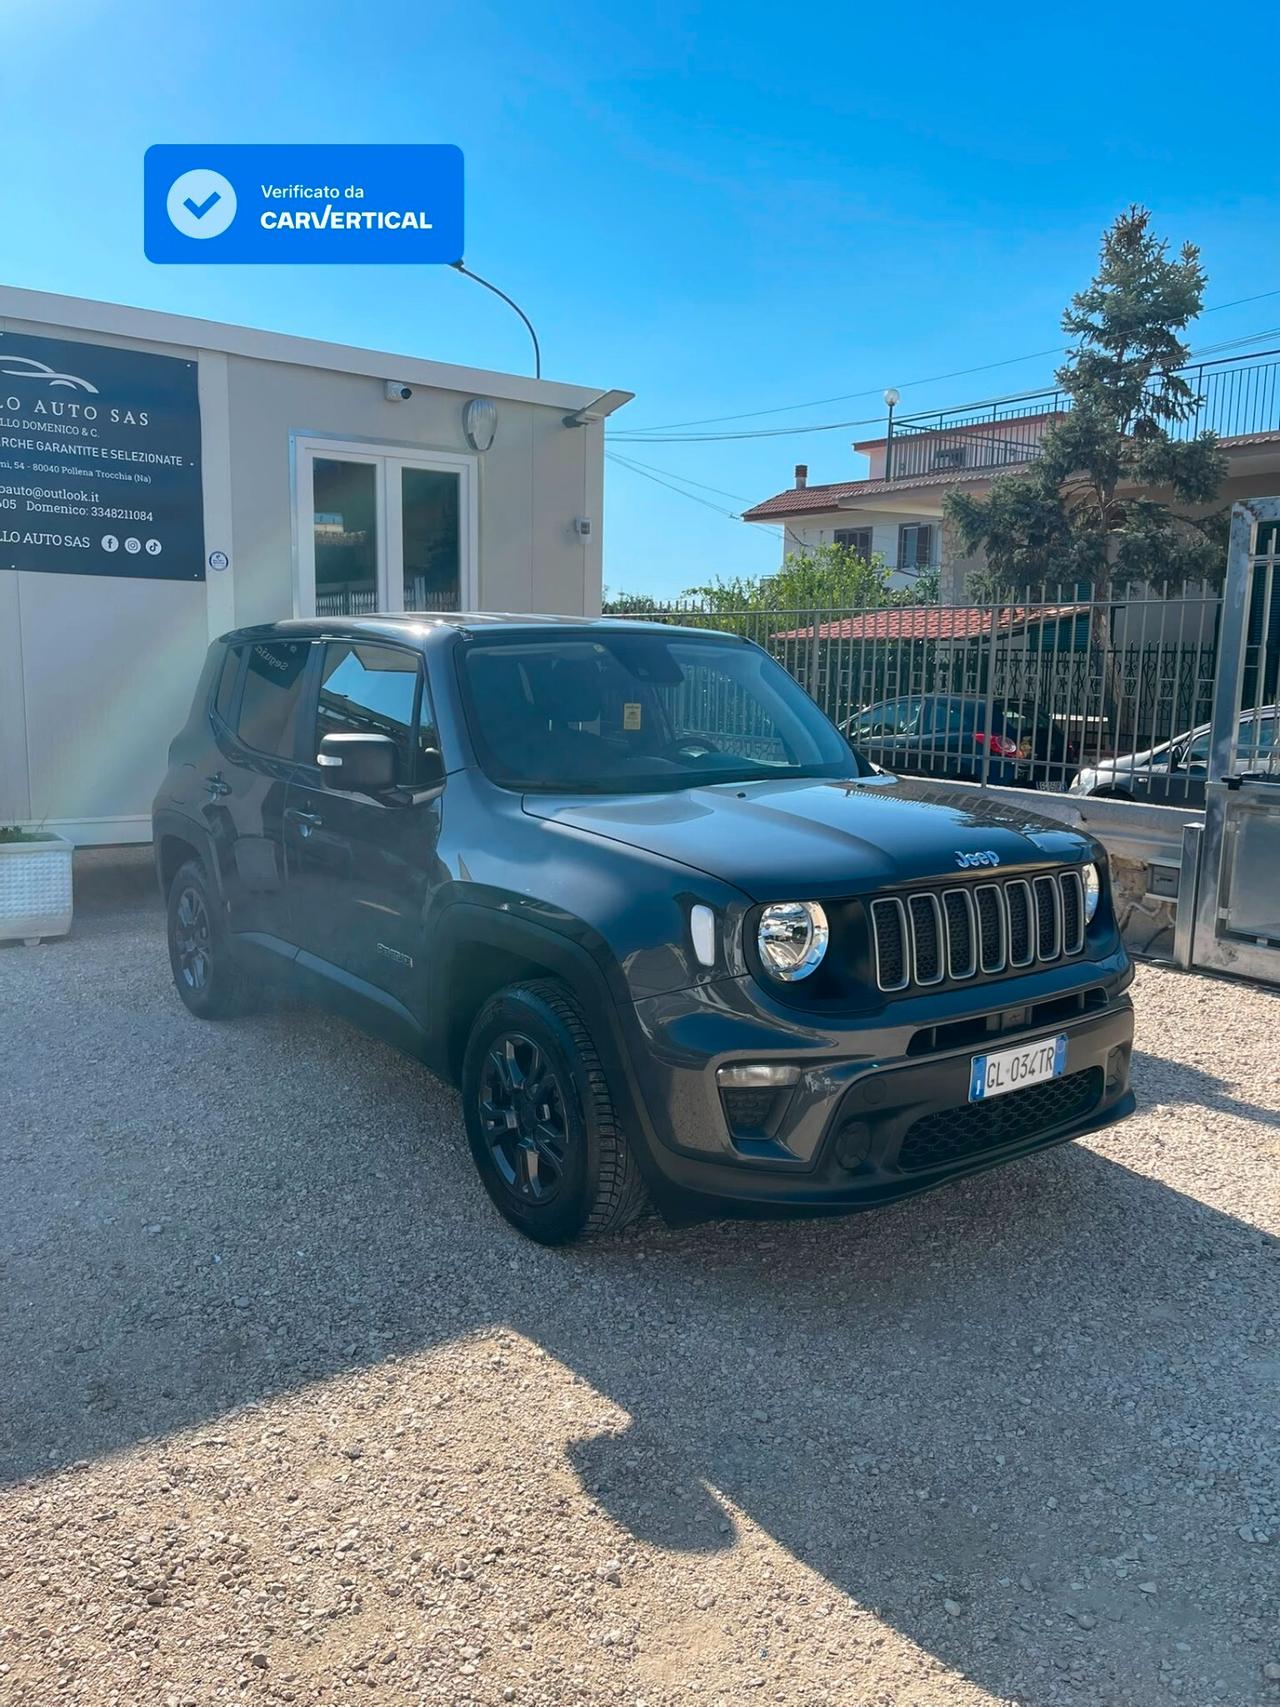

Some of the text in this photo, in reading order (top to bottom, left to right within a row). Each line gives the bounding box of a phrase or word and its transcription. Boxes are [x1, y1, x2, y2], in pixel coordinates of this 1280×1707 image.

[0, 396, 149, 427] O AUTO SAS
[22, 419, 80, 436] DOMENICO
[81, 427, 89, 436] &
[90, 428, 100, 438] C.
[0, 437, 183, 467] RCHE GARANTITE E SELEZIONATE
[14, 461, 25, 470] 54
[32, 463, 60, 474] 80040
[61, 466, 94, 477] Pollena
[95, 469, 133, 481] Trocchia
[133, 473, 152, 485] (Na)
[26, 500, 89, 517] Domenico:
[91, 506, 154, 522] 3348211084
[0, 530, 21, 544] LO
[23, 532, 62, 547] AUTO
[64, 536, 91, 548] SAS
[954, 850, 1000, 869] Jeep
[986, 1061, 1004, 1089] GL
[1010, 1045, 1055, 1082] 034TR
